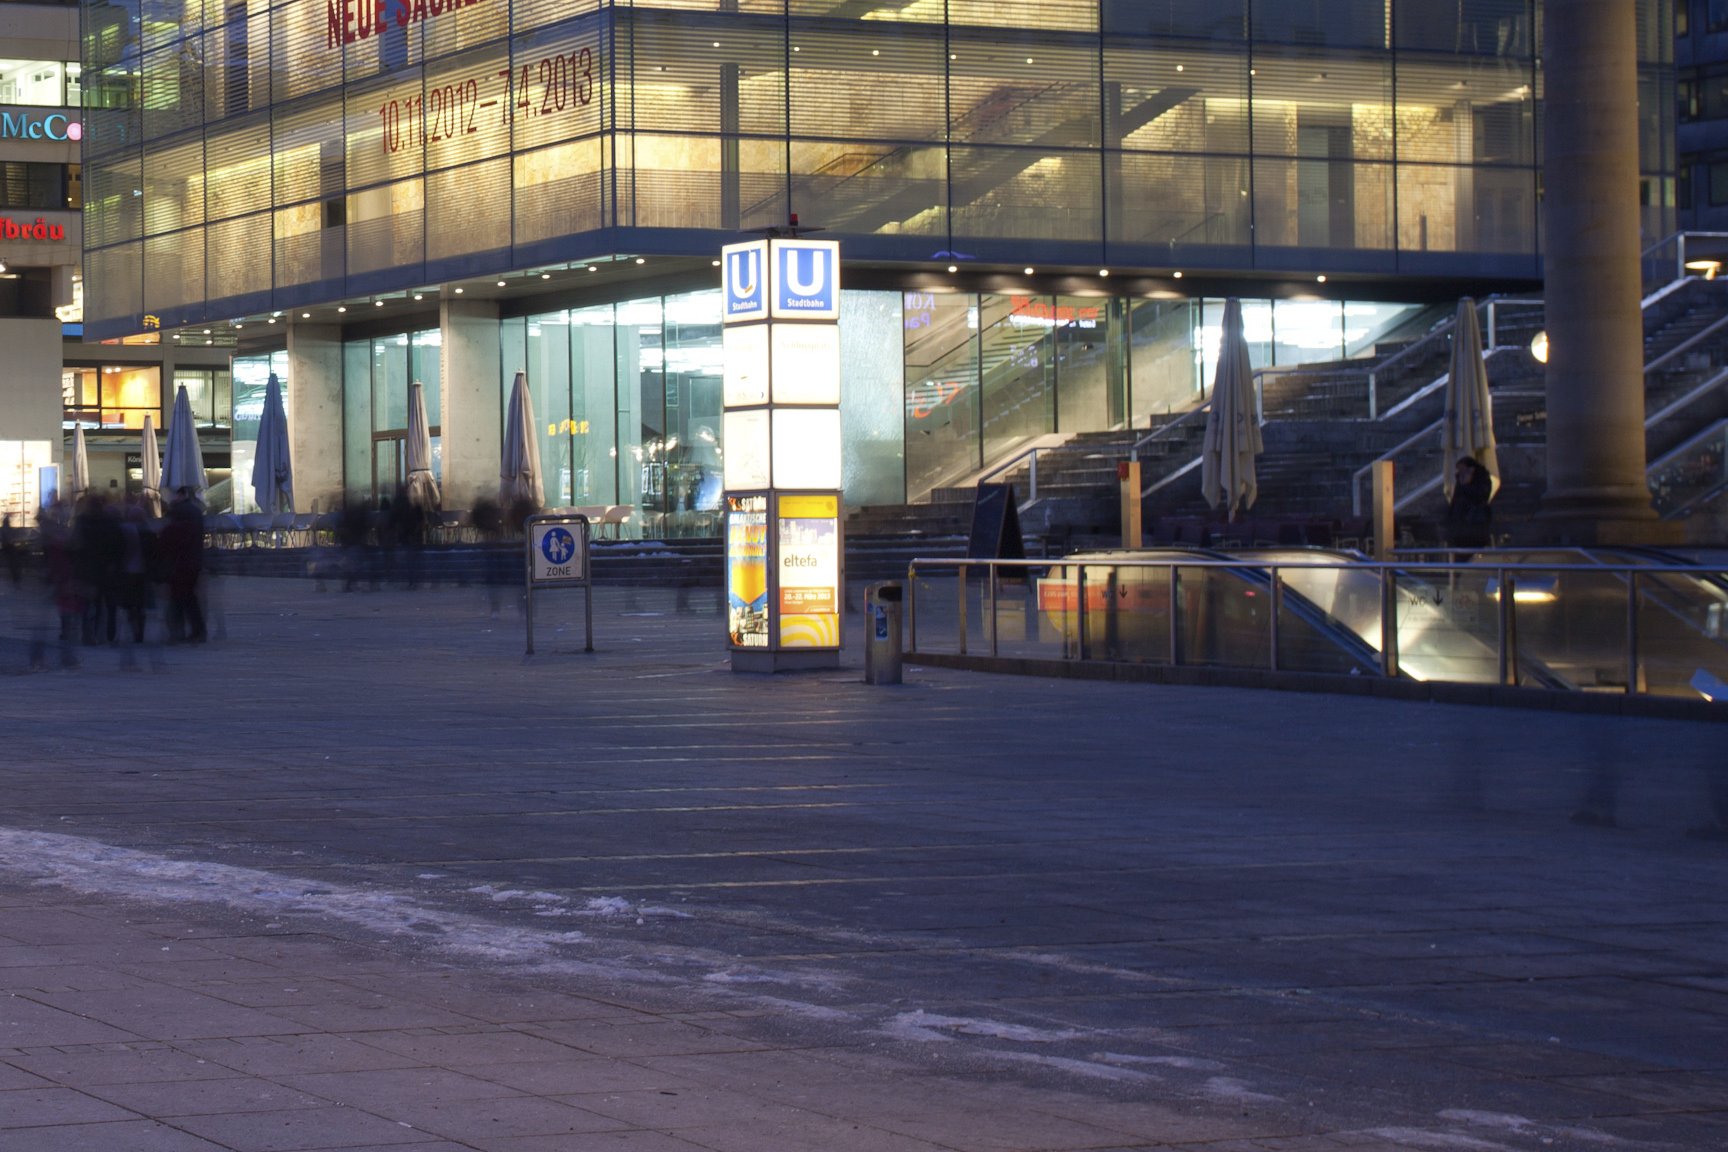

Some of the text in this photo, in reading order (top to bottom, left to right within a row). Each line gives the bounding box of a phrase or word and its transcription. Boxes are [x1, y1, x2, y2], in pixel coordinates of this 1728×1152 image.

[732, 251, 757, 299] U
[787, 250, 824, 296] U
[732, 301, 758, 311] Stadtbahn
[787, 297, 825, 308] Stadtbahn
[783, 554, 818, 567] eltefa
[546, 566, 572, 576] ZONE
[742, 633, 769, 647] SATURN
